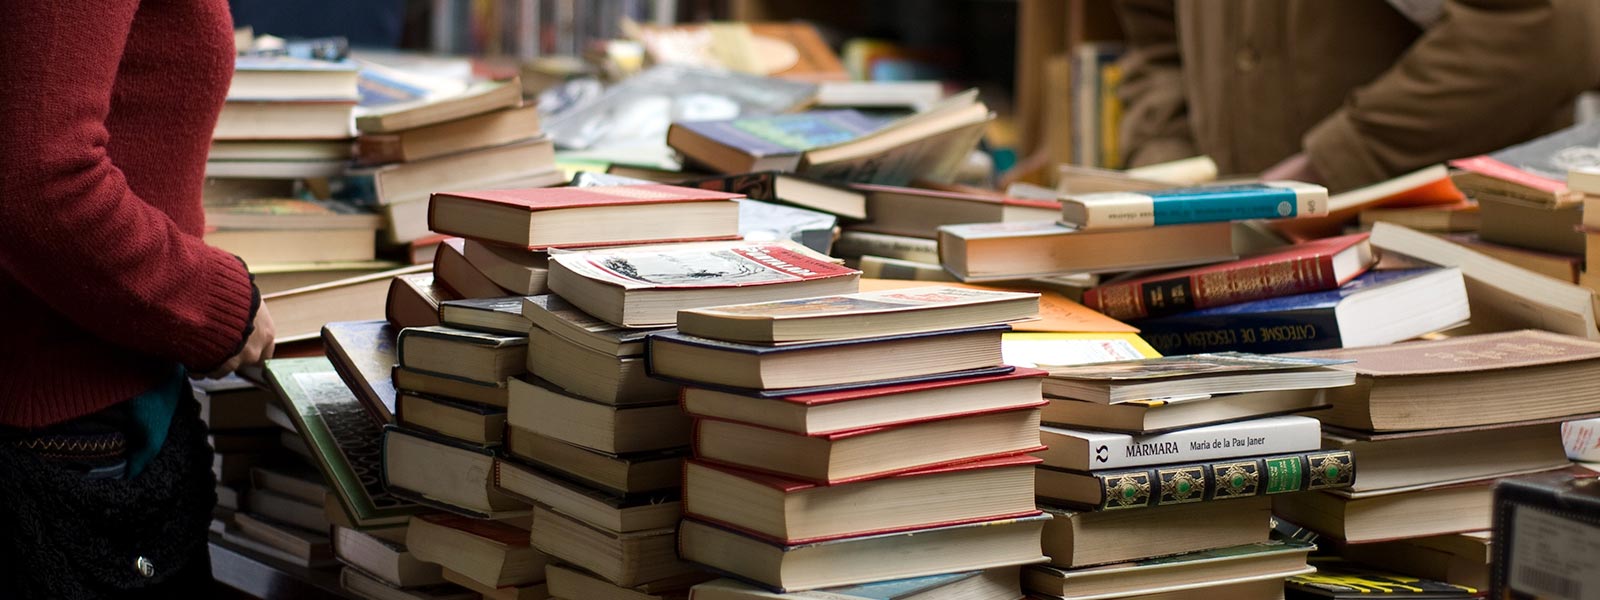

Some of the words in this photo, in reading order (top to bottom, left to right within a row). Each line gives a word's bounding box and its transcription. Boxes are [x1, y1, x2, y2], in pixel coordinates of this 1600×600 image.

[1239, 327, 1257, 345] DE
[1259, 323, 1317, 343] CATECISME
[1126, 442, 1179, 458] MÀRMARA
[1190, 441, 1211, 451] Maria
[1212, 439, 1222, 449] de
[1223, 438, 1231, 448] la
[1232, 437, 1246, 447] Pau
[1247, 436, 1265, 447] Janer
